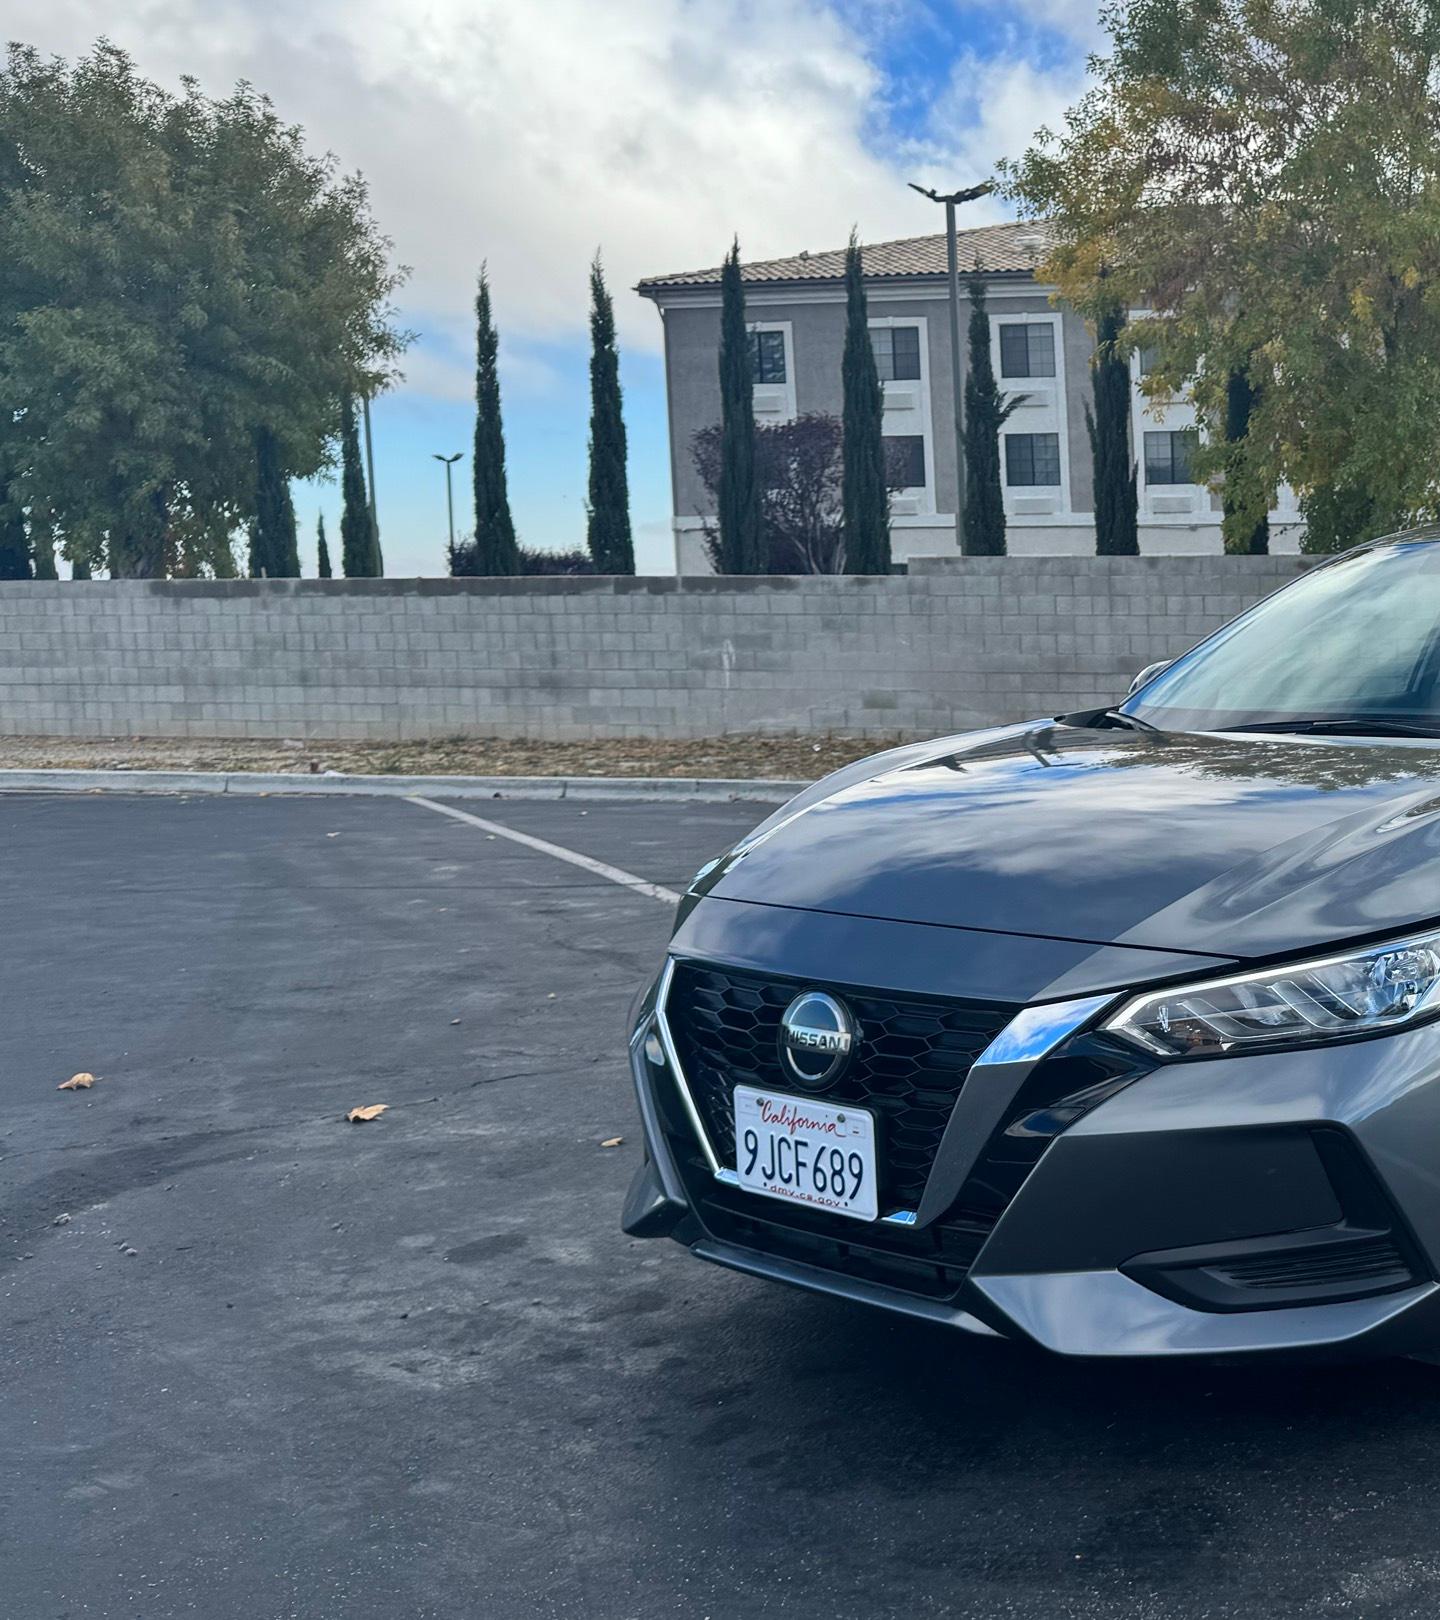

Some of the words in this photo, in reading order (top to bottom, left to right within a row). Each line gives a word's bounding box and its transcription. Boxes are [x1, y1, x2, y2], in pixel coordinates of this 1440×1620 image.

[786, 1029, 840, 1051] NISSAN
[762, 1100, 846, 1137] California
[744, 1129, 863, 1200] 9JCF689
